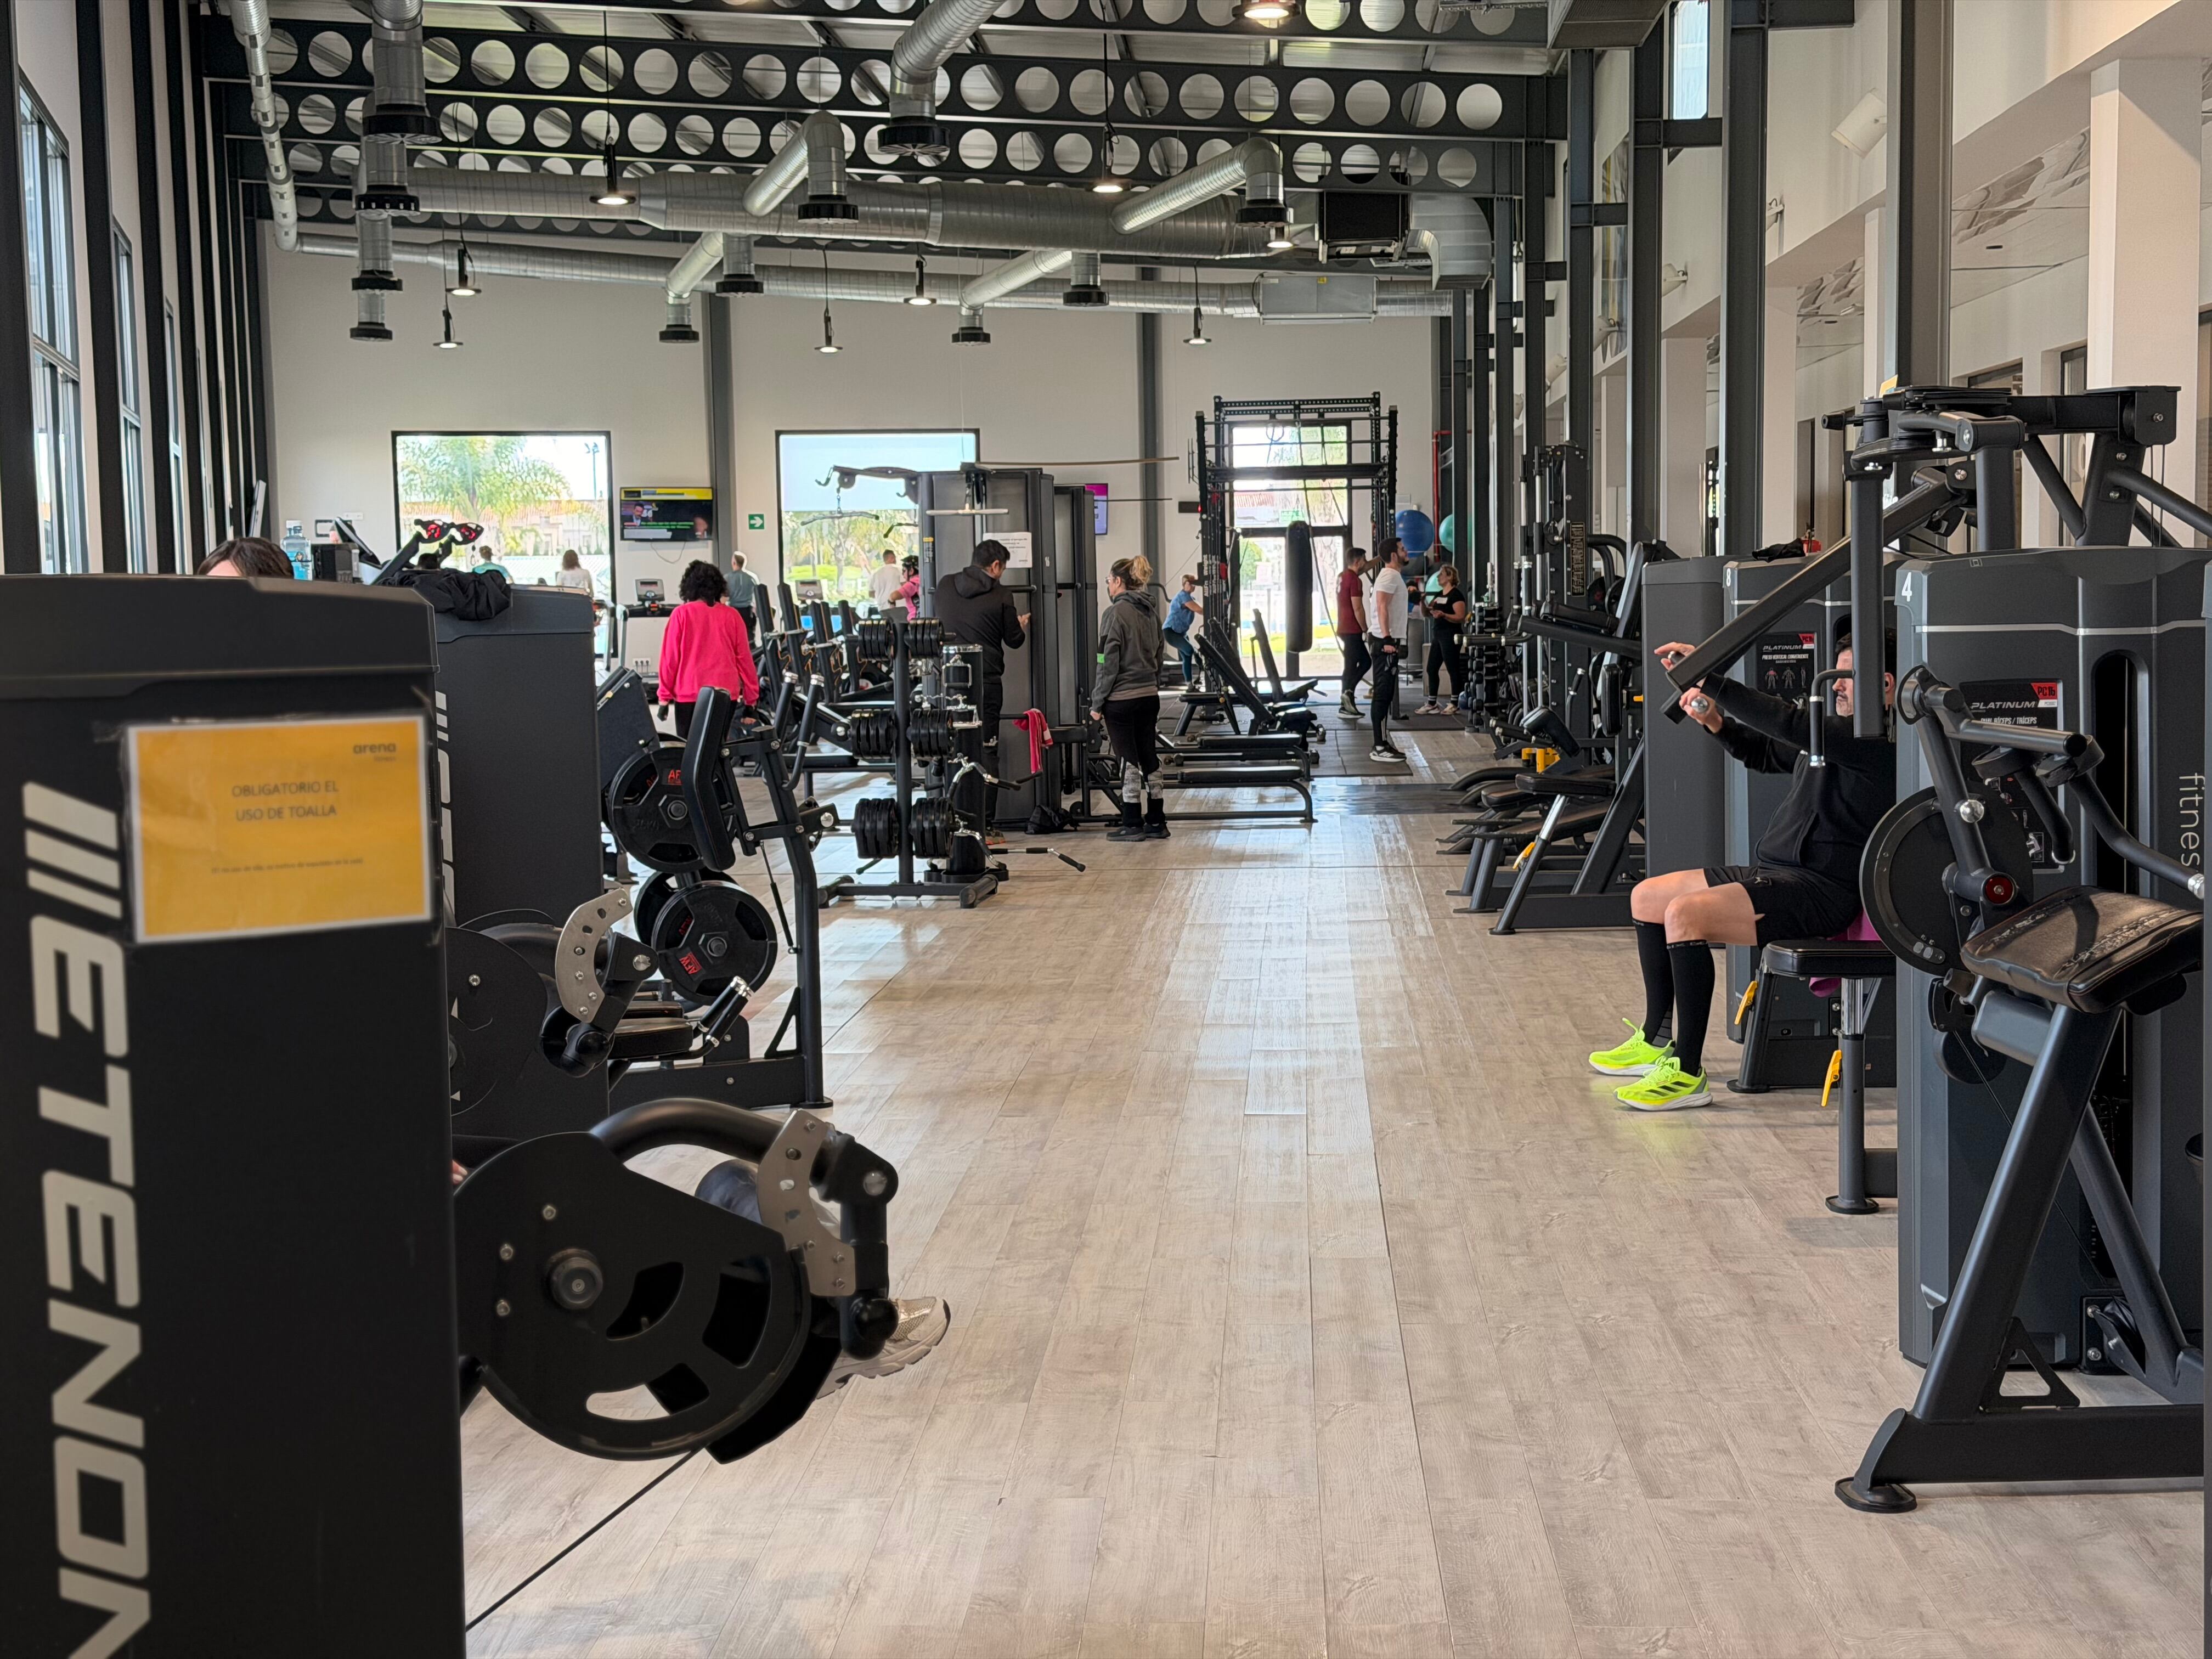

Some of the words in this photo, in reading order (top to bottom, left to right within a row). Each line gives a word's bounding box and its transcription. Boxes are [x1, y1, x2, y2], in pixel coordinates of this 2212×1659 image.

[1726, 568, 1731, 586] 8
[1901, 572, 1912, 602] 4
[2017, 716, 2037, 724] TRÍCEPS
[353, 743, 396, 754] arena
[668, 769, 681, 780] AF
[232, 781, 321, 797] OBLIGATORIO
[325, 781, 339, 793] EL
[236, 809, 263, 822] USO
[268, 807, 284, 820] DE
[289, 804, 337, 818] TOALLA
[2179, 772, 2205, 867] fitnes
[679, 955, 698, 974] AFW
